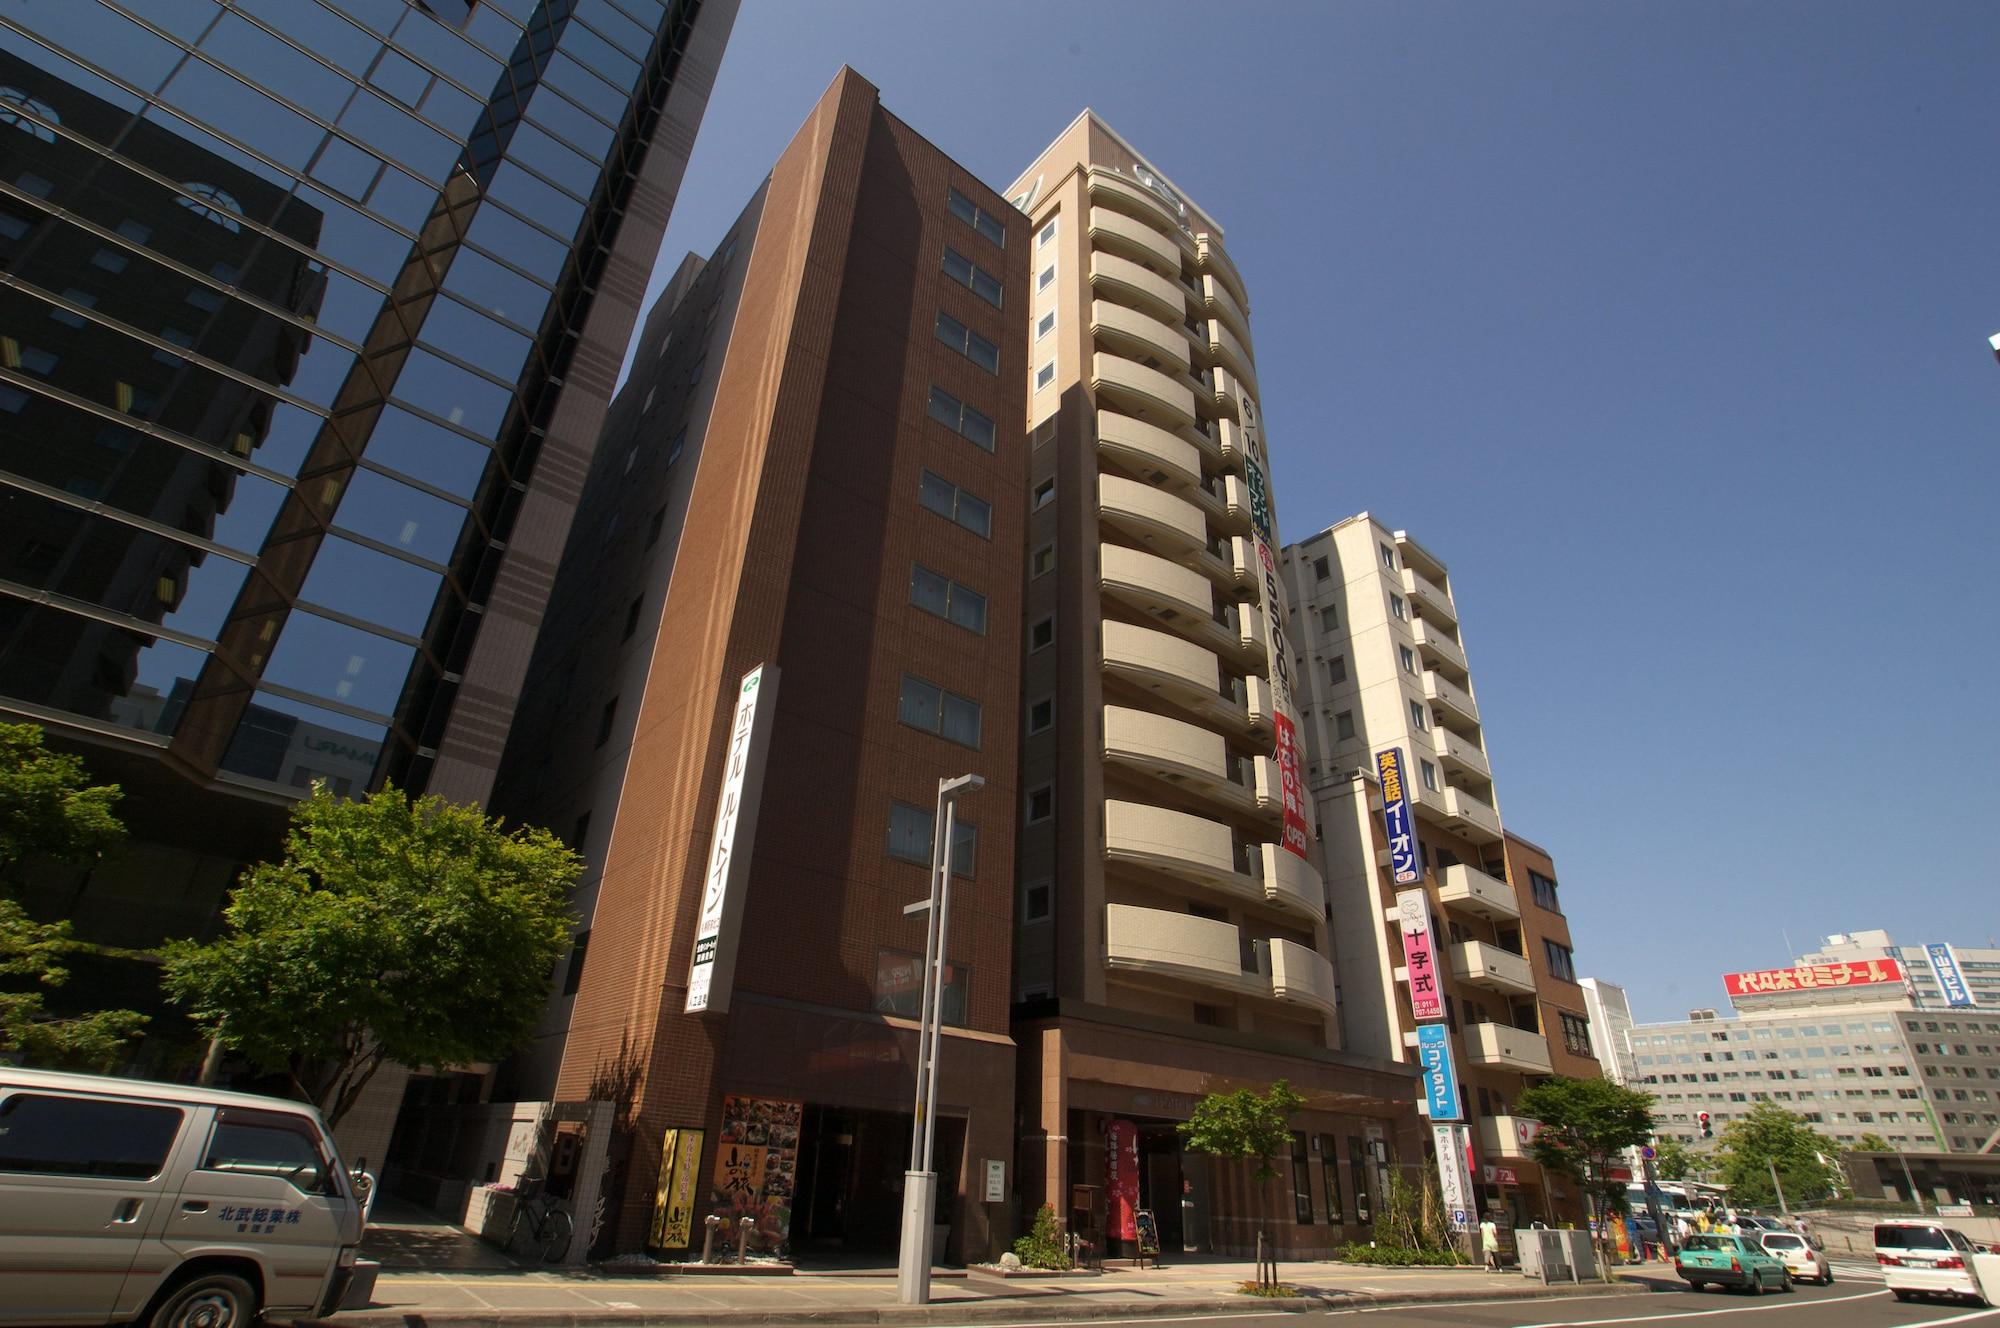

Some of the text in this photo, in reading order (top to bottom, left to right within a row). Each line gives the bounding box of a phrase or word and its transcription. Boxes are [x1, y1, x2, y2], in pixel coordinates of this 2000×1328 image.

[728, 703, 753, 782] ホテル
[707, 791, 738, 914] ルートイン
[1286, 823, 1306, 851] OPEN
[1408, 928, 1433, 992] 十字式
[1428, 1050, 1448, 1109] コンタクト
[1439, 1136, 1451, 1161] ホテル
